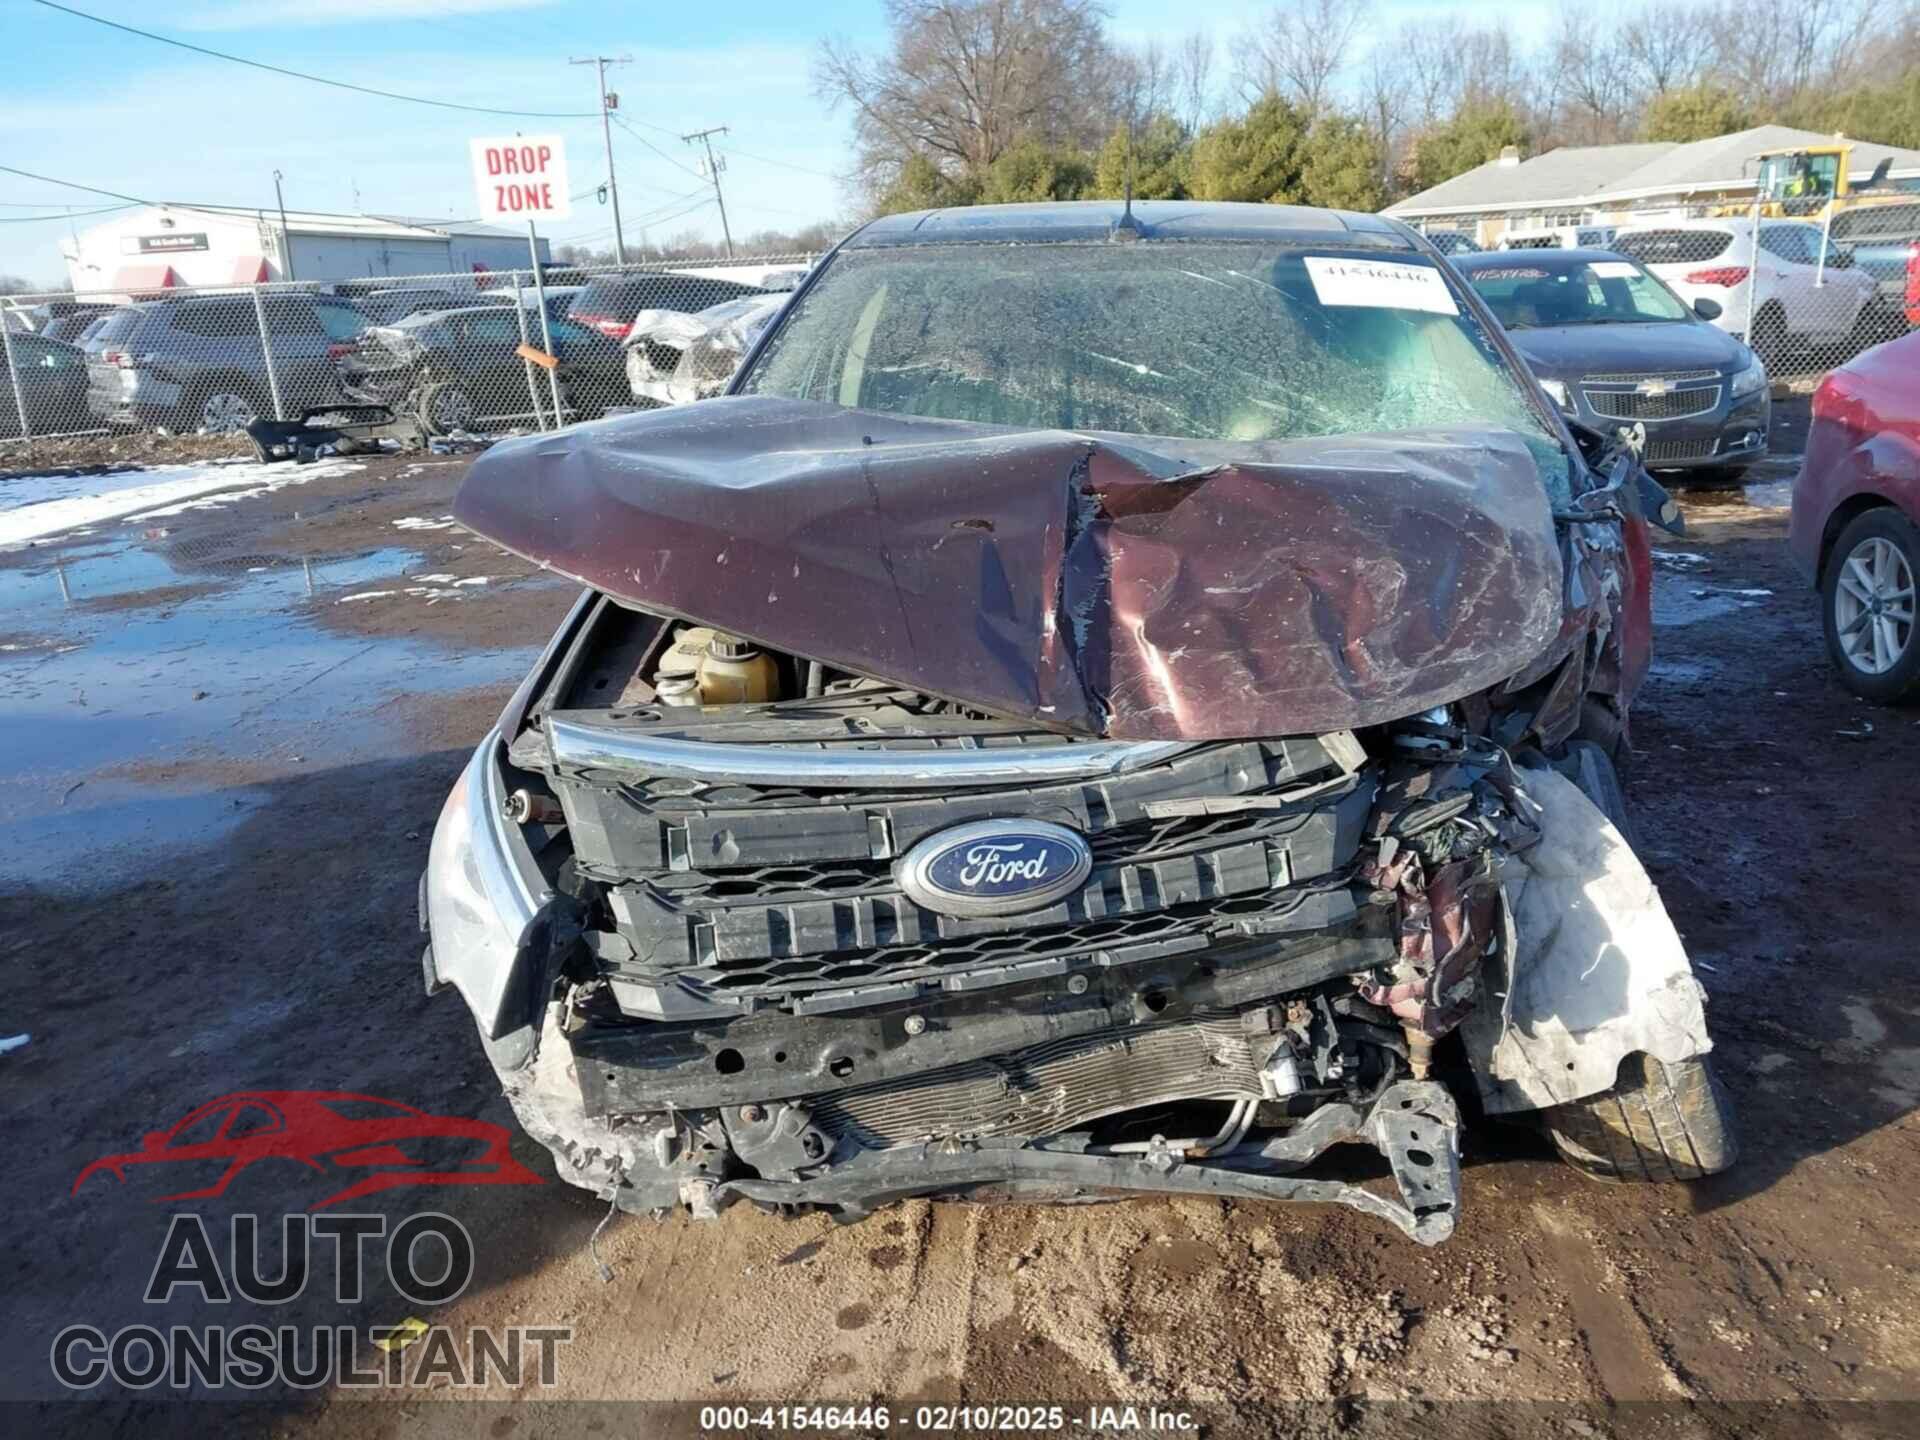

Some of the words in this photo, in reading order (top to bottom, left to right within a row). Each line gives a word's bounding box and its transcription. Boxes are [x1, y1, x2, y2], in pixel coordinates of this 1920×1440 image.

[485, 145, 552, 176] DROP
[494, 182, 554, 212] ZONE
[959, 842, 1048, 887] Ford
